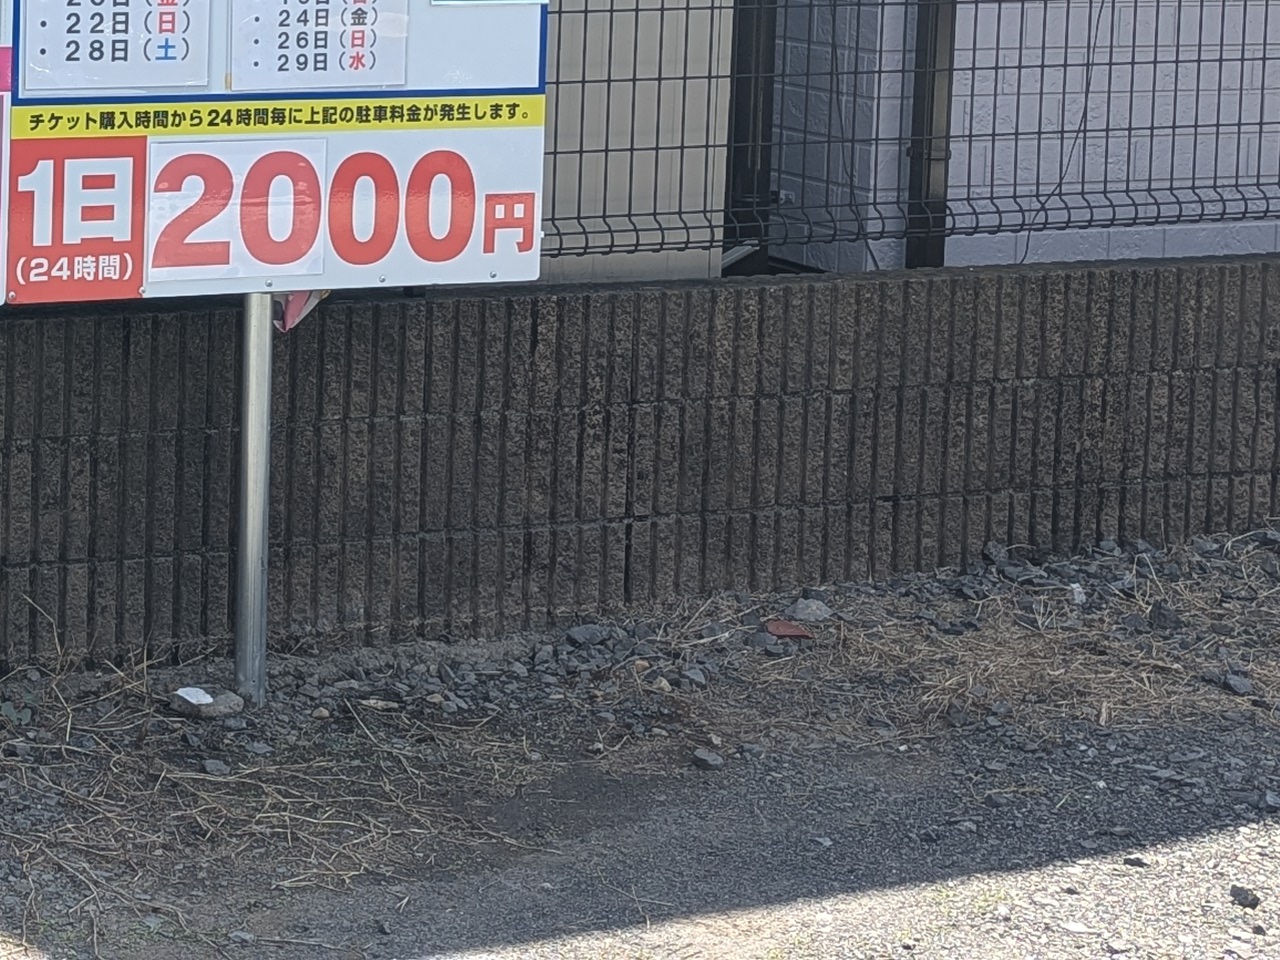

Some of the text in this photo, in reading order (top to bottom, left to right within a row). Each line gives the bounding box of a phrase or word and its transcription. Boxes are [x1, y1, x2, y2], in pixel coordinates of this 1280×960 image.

[29, 102, 529, 131] チケット購入時間から24時間毎に上記の駐車料金が発生します。
[18, 157, 134, 246] 1日
[151, 150, 536, 269] 2000円
[16, 255, 133, 285] (24時間)
